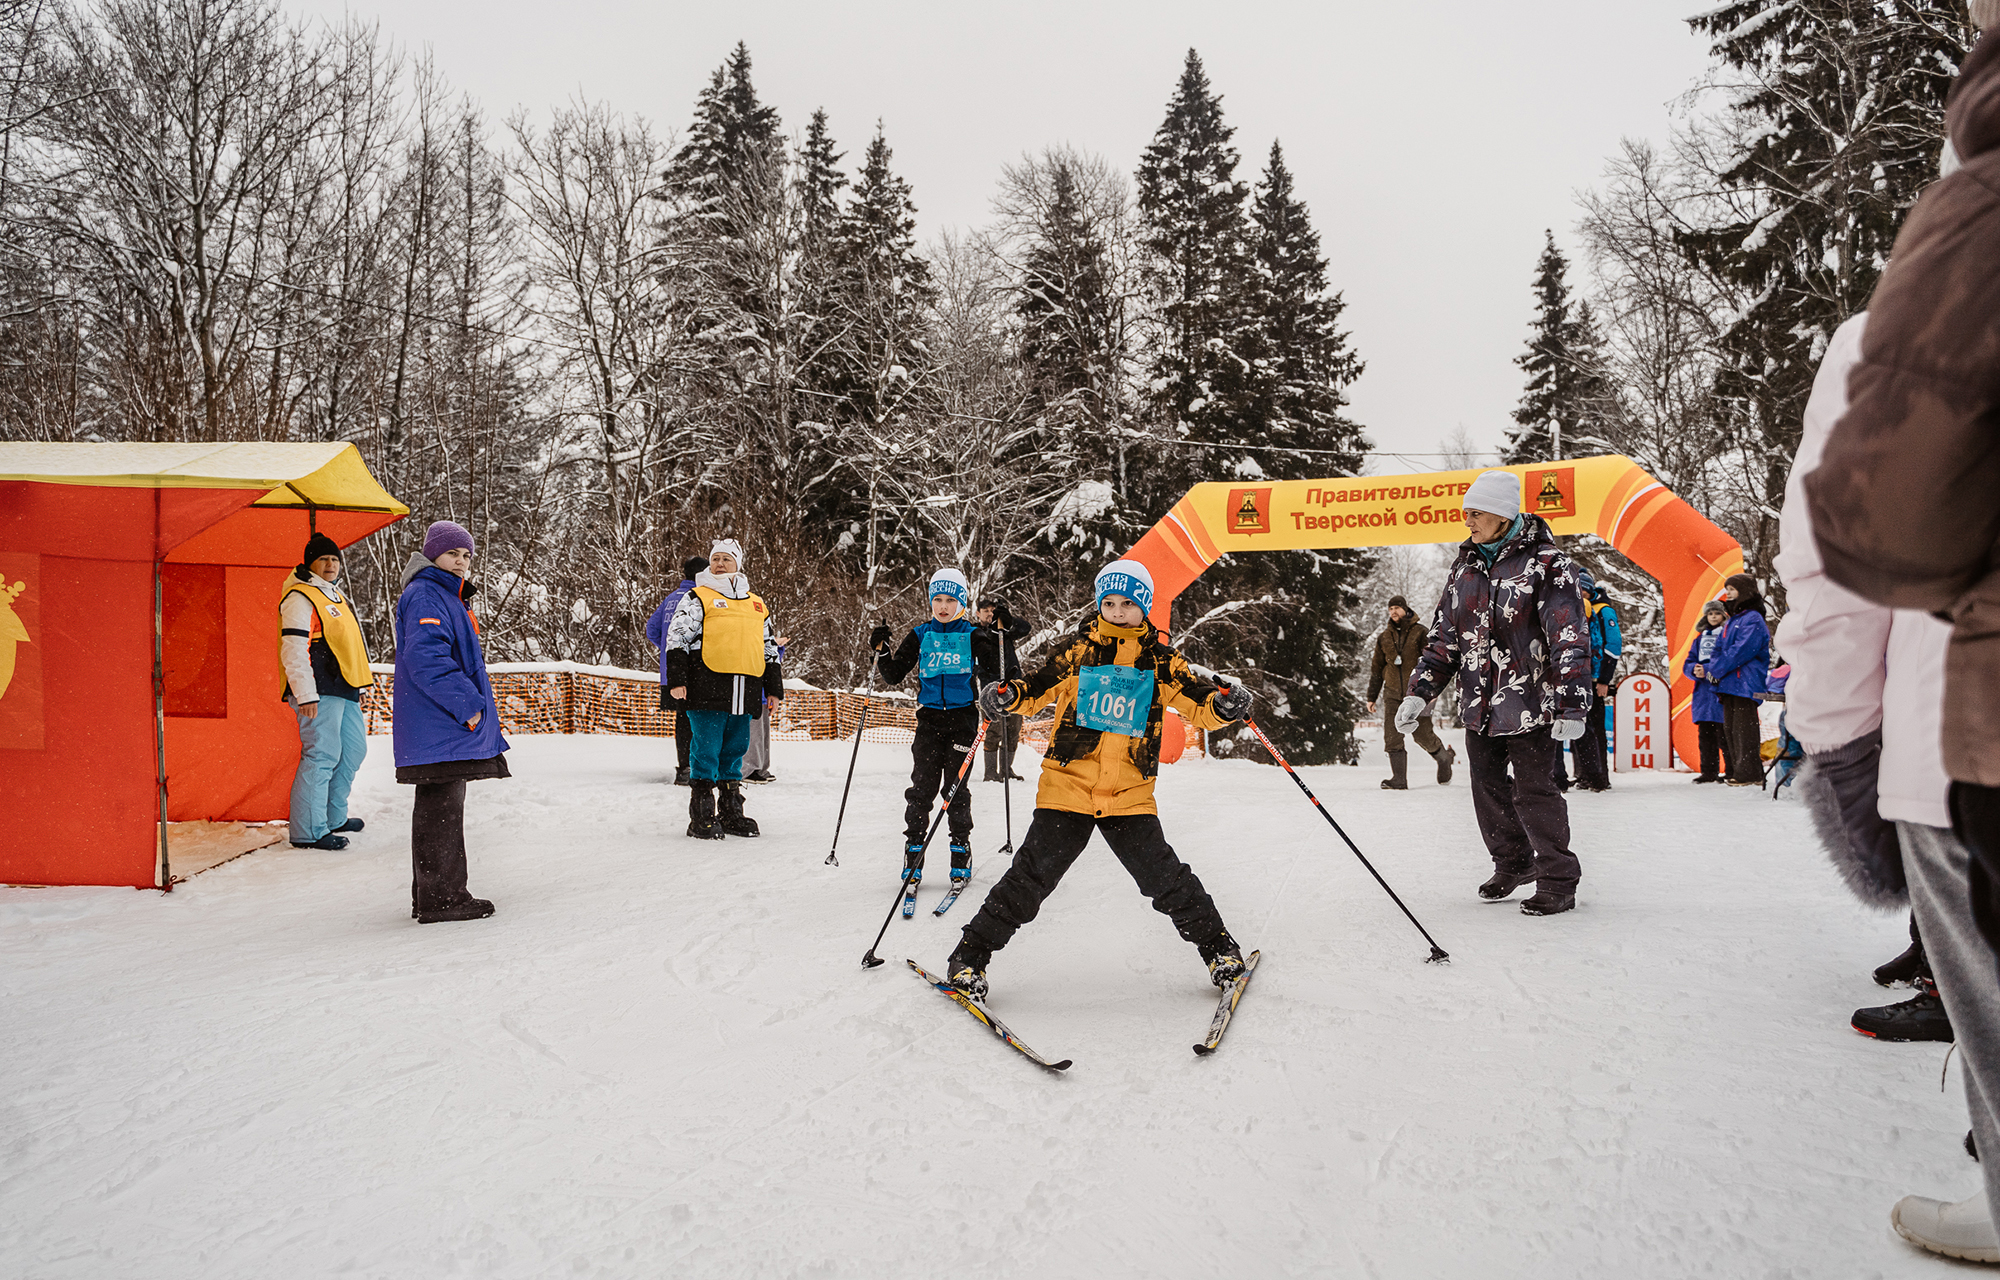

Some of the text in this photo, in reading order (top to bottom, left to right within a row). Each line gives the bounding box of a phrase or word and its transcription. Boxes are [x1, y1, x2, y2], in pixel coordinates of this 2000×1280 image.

[1306, 482, 1471, 508] Правительств
[1290, 505, 1467, 532] Тверской обла
[928, 652, 961, 667] 2758
[1089, 691, 1136, 721] 1061
[1631, 680, 1653, 769] ФИНИШ
[1254, 727, 1284, 762] MADSHUS
